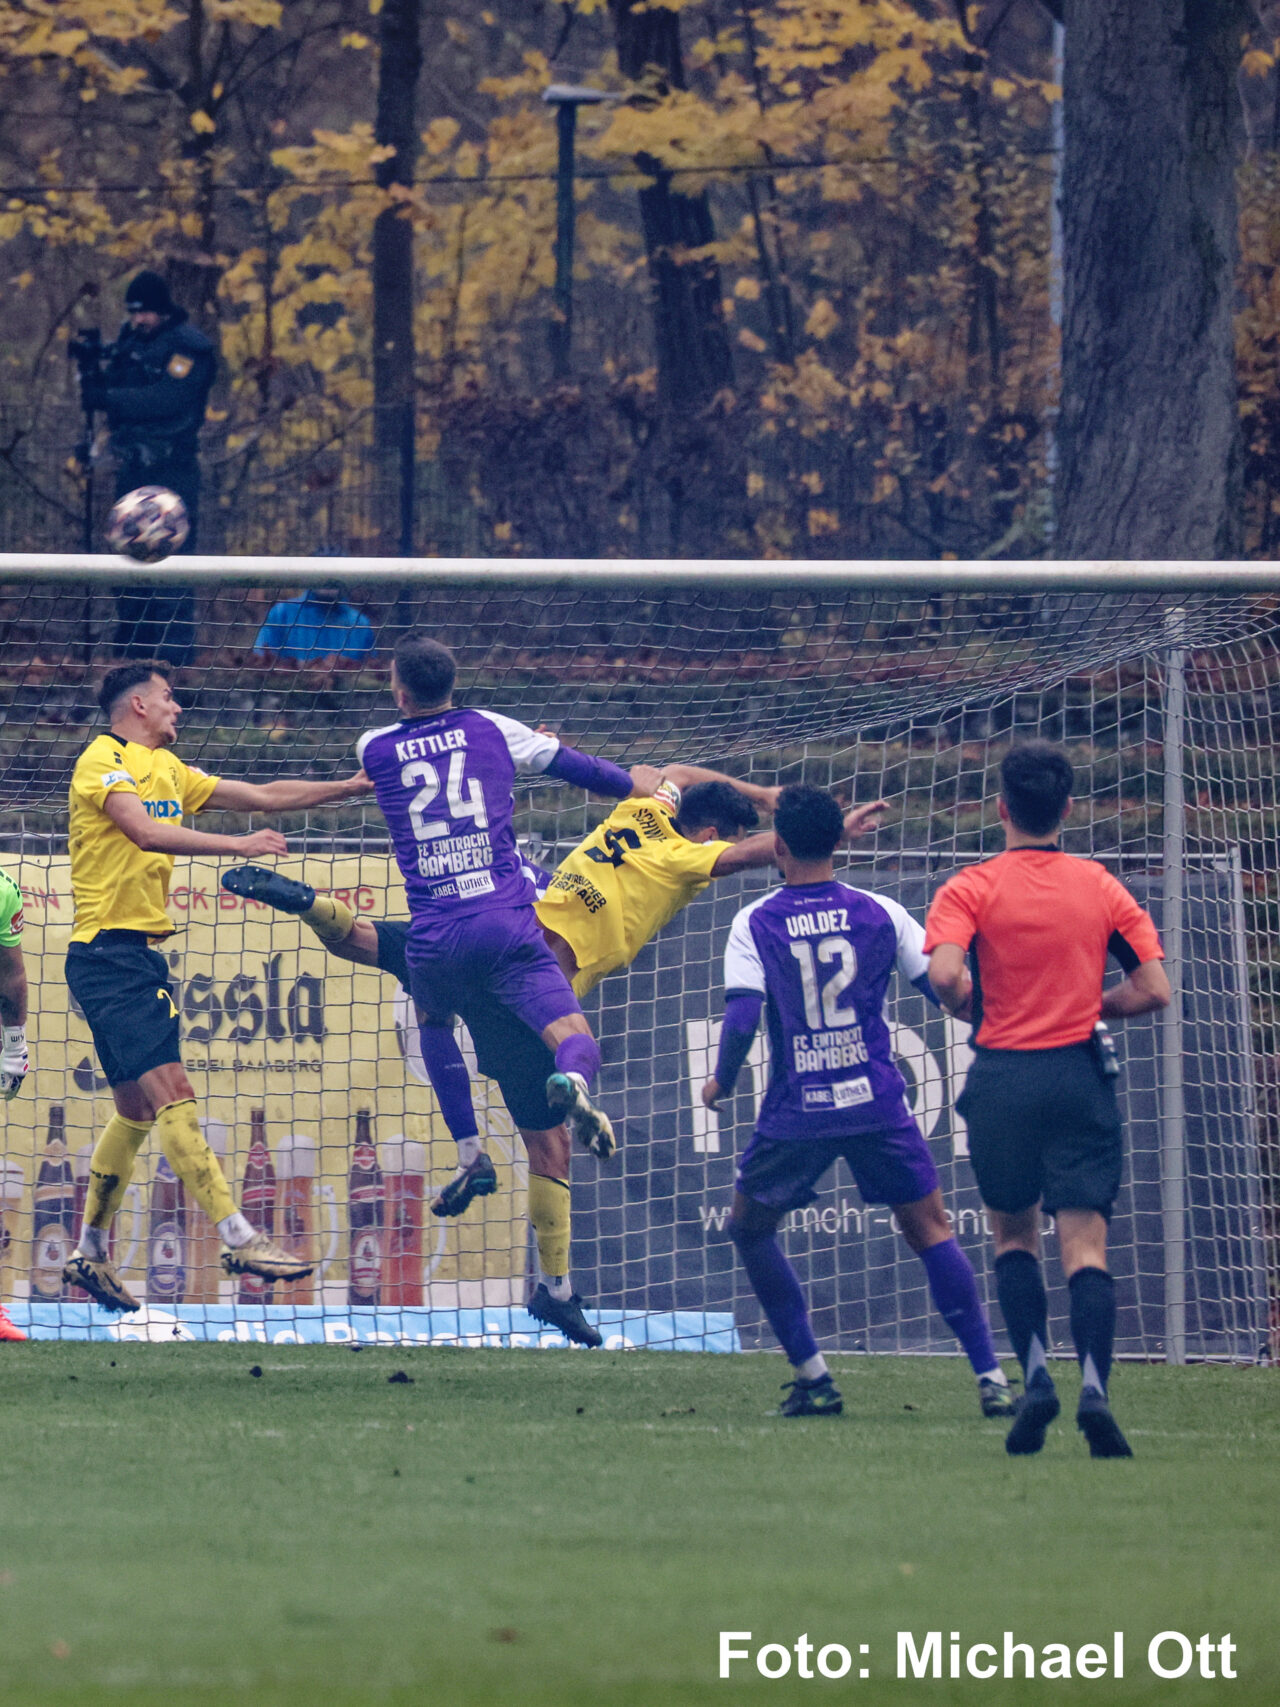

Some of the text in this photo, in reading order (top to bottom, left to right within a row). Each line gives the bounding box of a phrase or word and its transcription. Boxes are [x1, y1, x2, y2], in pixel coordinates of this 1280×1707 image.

[395, 729, 468, 762] KETTLER
[401, 750, 489, 842] 24
[432, 832, 490, 854] EINTRACHT
[417, 846, 493, 878] BAMBERG
[459, 876, 490, 892] LUTHER
[785, 909, 851, 938] VALDEZ
[790, 936, 857, 1030] 12
[792, 1034, 809, 1050] FC
[794, 1041, 870, 1074] BAMBERG
